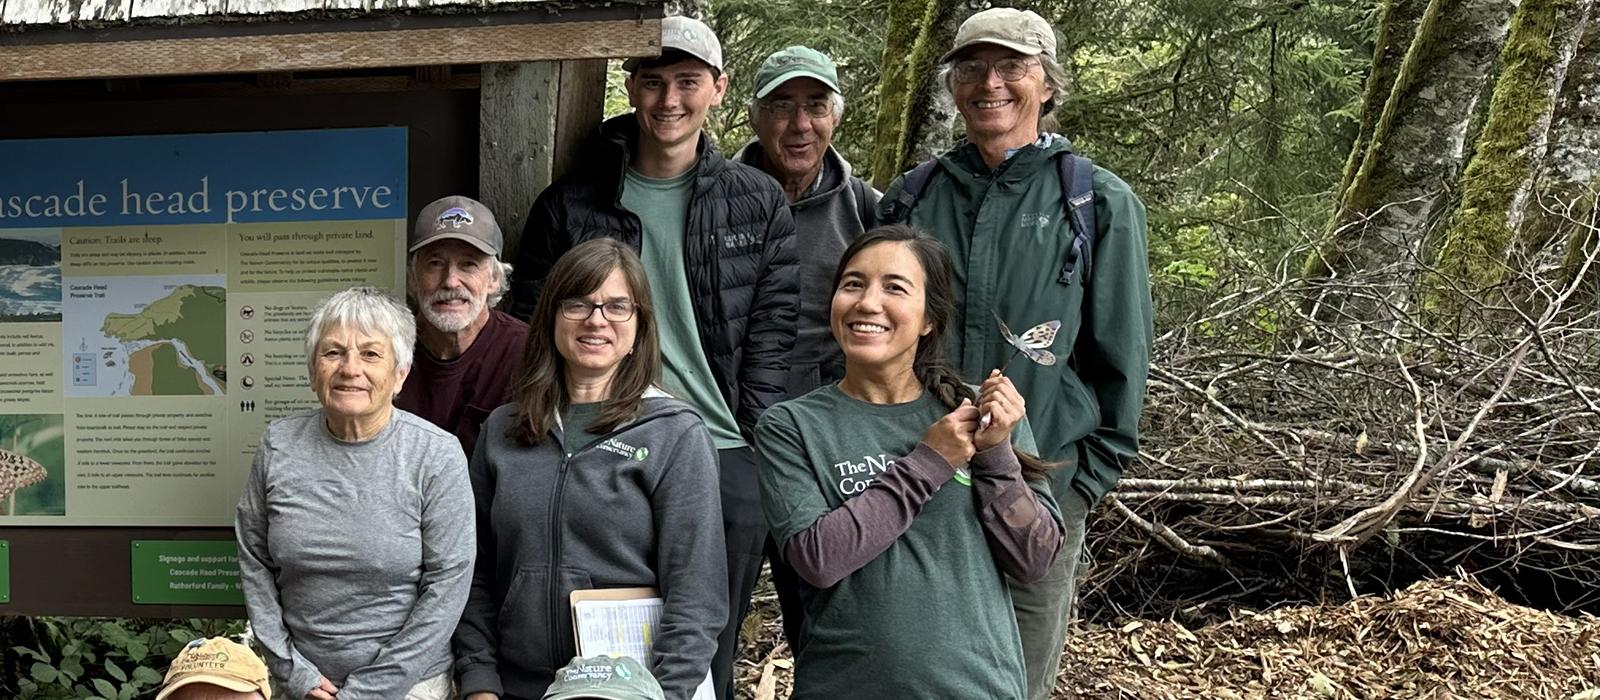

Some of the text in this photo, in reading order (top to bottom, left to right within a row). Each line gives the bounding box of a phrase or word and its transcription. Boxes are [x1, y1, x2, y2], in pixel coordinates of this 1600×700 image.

[120, 176, 212, 216] head
[226, 184, 392, 224] preserve
[104, 236, 126, 244] Trails
[239, 230, 374, 242] You will pass through private land.
[608, 438, 636, 453] Nature
[834, 460, 866, 476] The
[159, 555, 186, 563] Signage
[182, 661, 225, 670] VOLUNTEER
[578, 664, 612, 673] Nature
[564, 672, 612, 682] Conservancy
